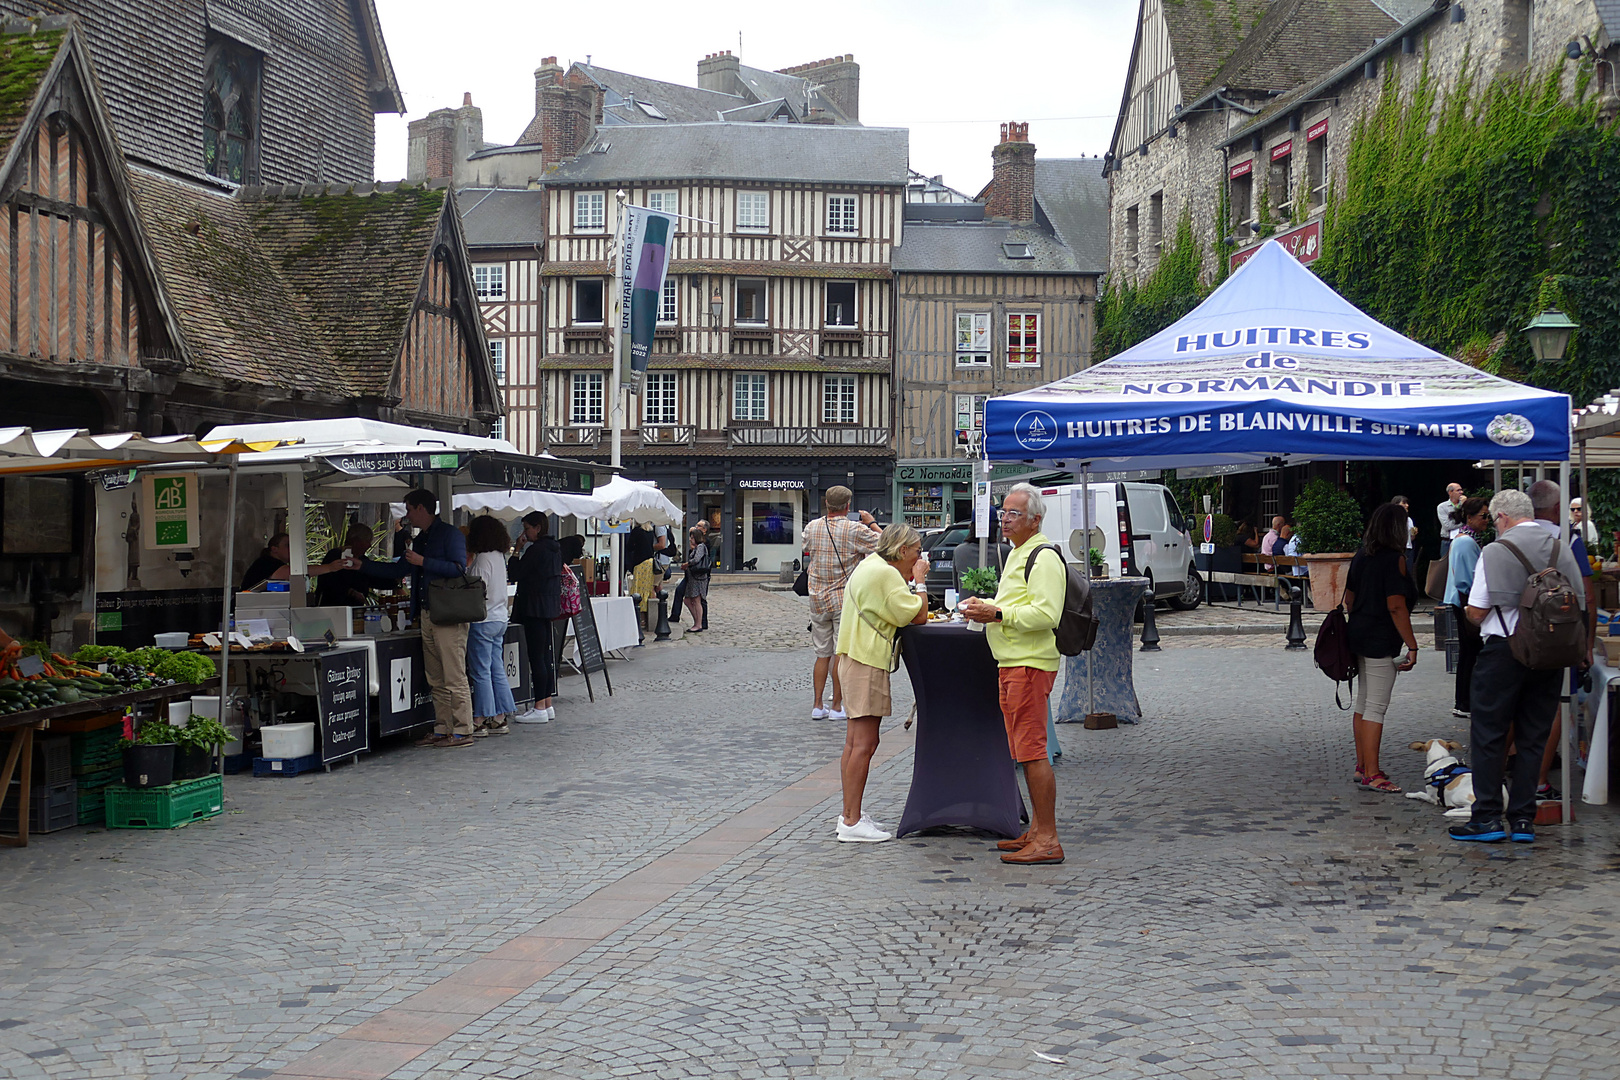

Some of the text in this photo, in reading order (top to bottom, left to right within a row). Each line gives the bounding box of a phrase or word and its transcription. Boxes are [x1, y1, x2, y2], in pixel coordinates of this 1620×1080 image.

[623, 276, 632, 309] PHARE
[622, 313, 630, 329] UN
[1176, 327, 1370, 352] HUITRES
[1245, 352, 1298, 369] de
[1122, 376, 1423, 397] NORMANDIE
[1066, 412, 1475, 439] HUITRES DE BLAINVILLE sur MER
[341, 458, 376, 471] Galettes
[377, 460, 396, 471] sans
[398, 458, 424, 471] gluten
[919, 465, 973, 480] Normandie
[739, 480, 805, 488] GALERIES BARTOUX
[156, 486, 182, 509] AB
[327, 669, 346, 683] Gâteaux
[328, 708, 360, 726] Far aux pruneaux
